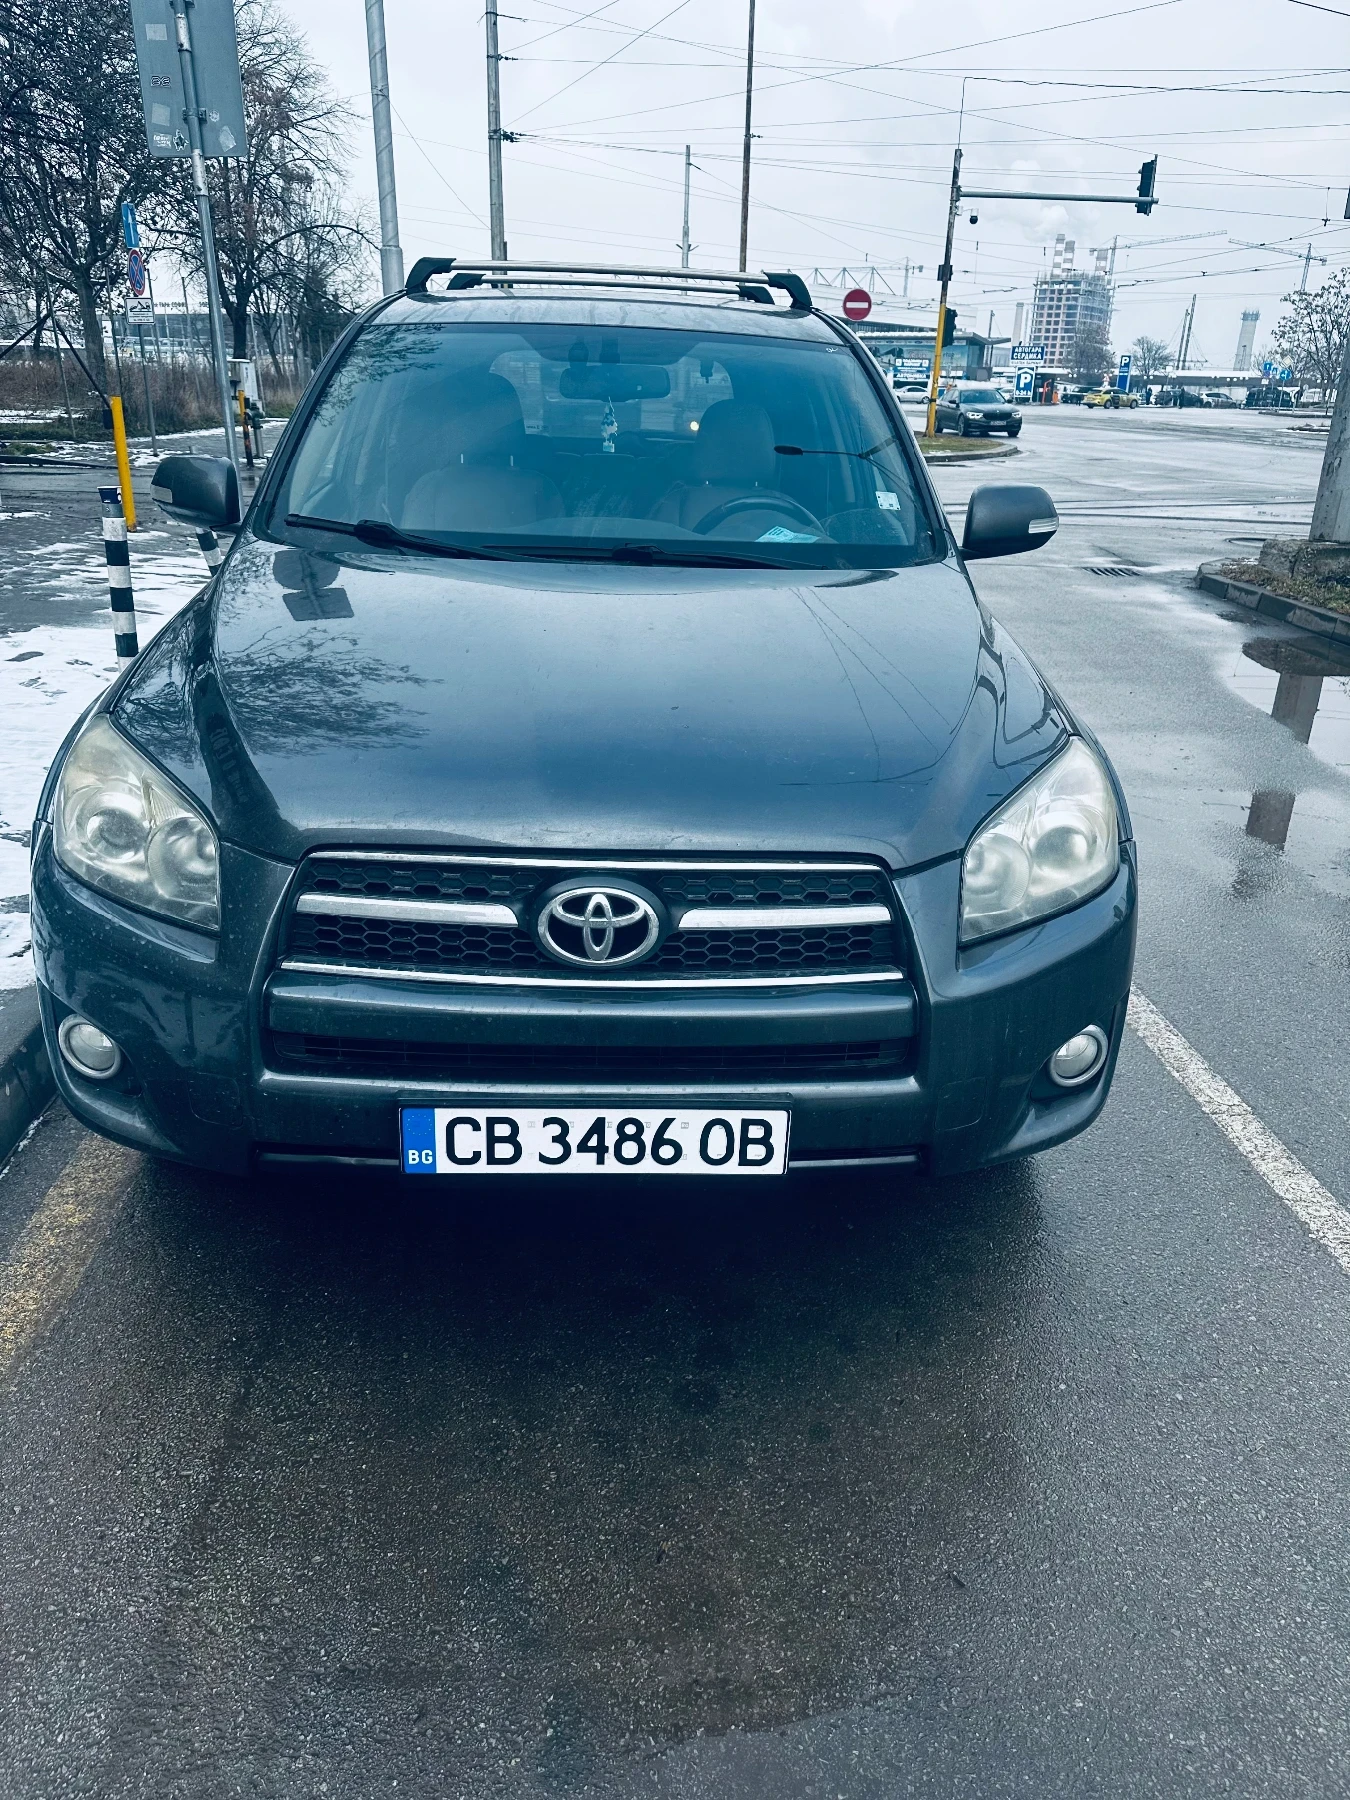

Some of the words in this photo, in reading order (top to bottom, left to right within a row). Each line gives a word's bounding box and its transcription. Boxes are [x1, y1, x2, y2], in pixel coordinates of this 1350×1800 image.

[1121, 357, 1129, 366] P
[1020, 374, 1031, 388] P
[445, 1116, 523, 1166] CB
[538, 1116, 683, 1166] 3486
[408, 1149, 434, 1164] BG
